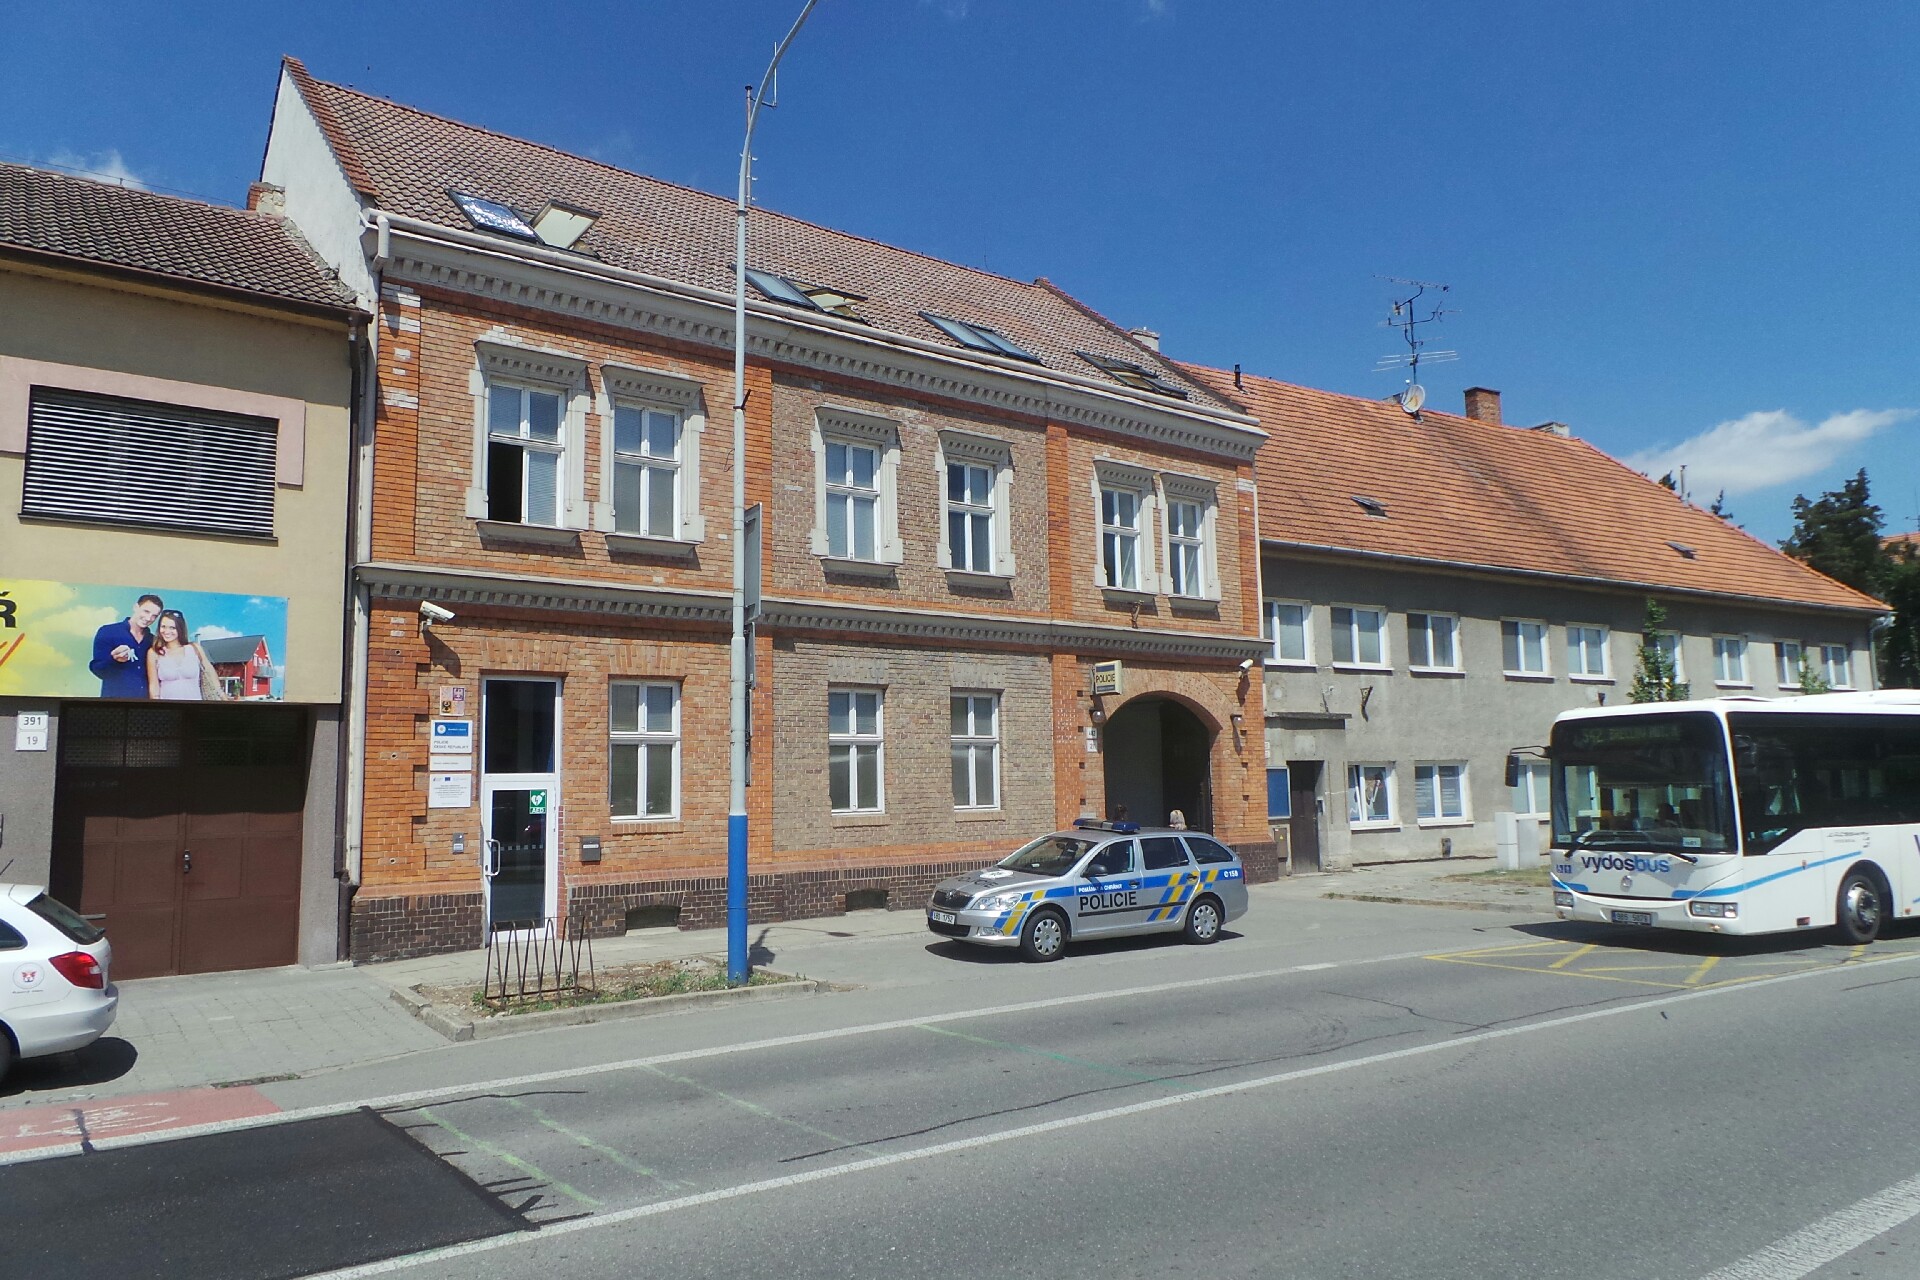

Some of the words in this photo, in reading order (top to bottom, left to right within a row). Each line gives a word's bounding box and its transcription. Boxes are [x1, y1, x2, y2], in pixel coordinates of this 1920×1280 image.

[1095, 673, 1116, 683] POLICIE
[24, 716, 42, 726] 391
[27, 735, 38, 745] 19
[1581, 854, 1671, 873] vydosbus
[1079, 891, 1138, 911] POLICIE
